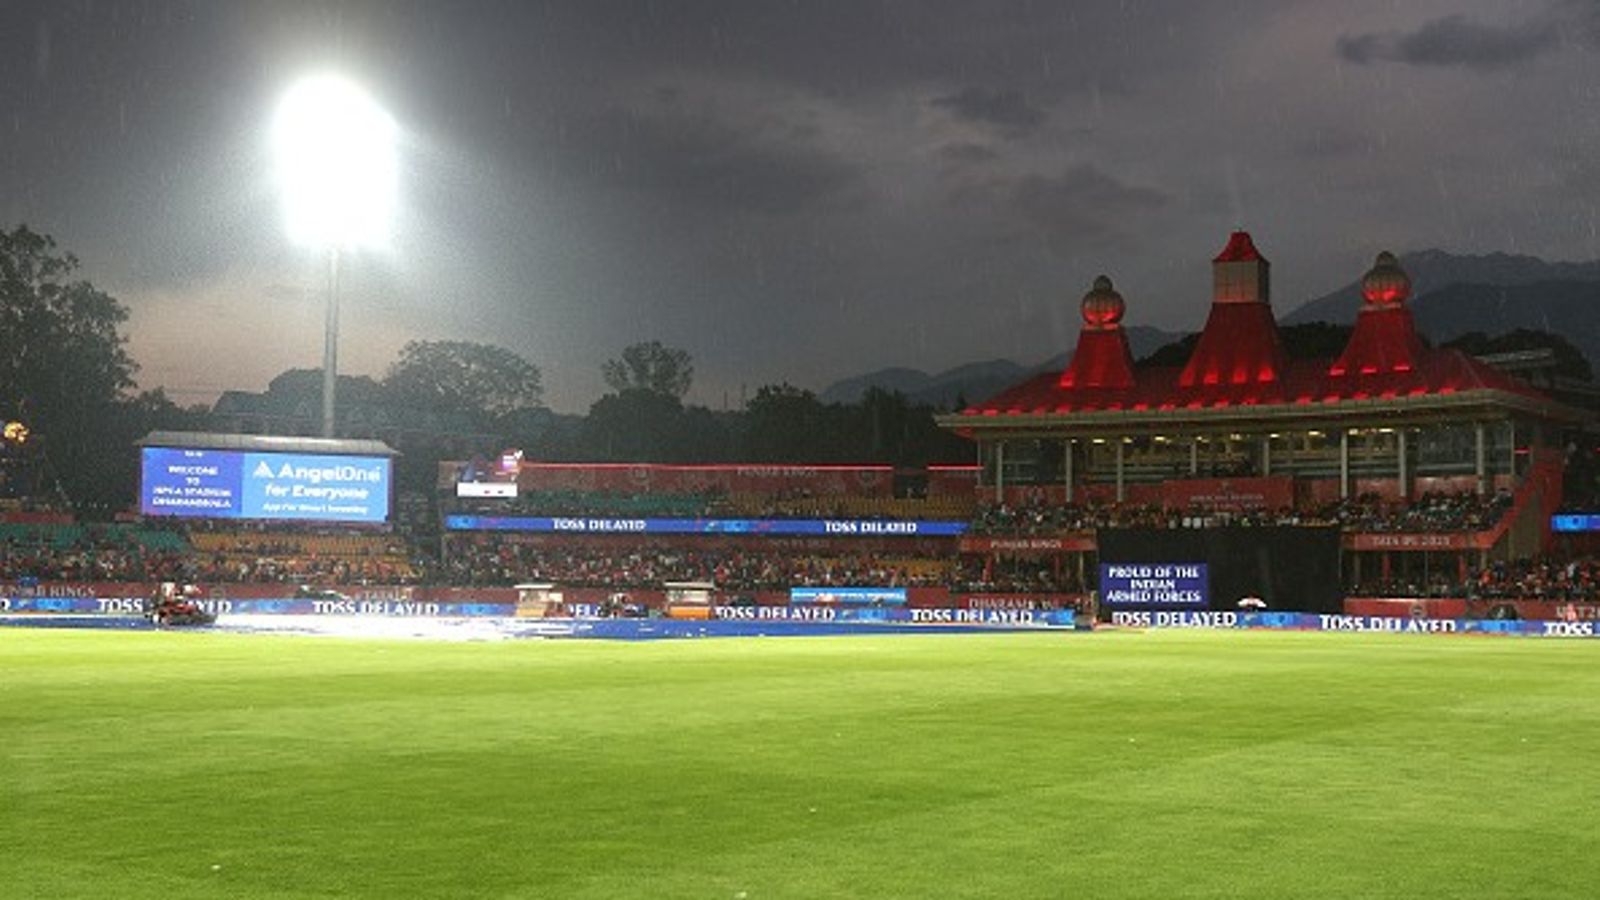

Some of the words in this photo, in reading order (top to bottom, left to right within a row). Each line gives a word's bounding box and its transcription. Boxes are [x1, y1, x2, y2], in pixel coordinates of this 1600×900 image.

[278, 463, 380, 483] AngelOne
[265, 484, 289, 497] for
[292, 485, 369, 499] Everyone
[552, 518, 585, 530] TOSS
[588, 519, 647, 531] DELAYED
[824, 520, 857, 533] TOSS
[861, 520, 917, 533] DELAYED
[1108, 566, 1151, 578] PROUD
[1154, 566, 1173, 578] OF
[1175, 566, 1199, 578] THE
[1130, 579, 1176, 589] INDIAN
[1106, 590, 1151, 602] ARMED
[1154, 590, 1202, 602] FORCES
[97, 598, 143, 613] TOSS
[312, 601, 357, 613] TOSS
[361, 602, 440, 615] DELAYED
[714, 606, 755, 619] TOSS
[758, 607, 835, 621] DELAYED
[910, 609, 952, 623] TOSS
[956, 609, 1033, 624] DELAYED
[1111, 611, 1151, 626] TOSS
[1156, 611, 1237, 628] DELAYED
[1319, 614, 1364, 630] TOSS
[1368, 616, 1456, 632] DELAYED
[1543, 622, 1593, 637] TOSS
